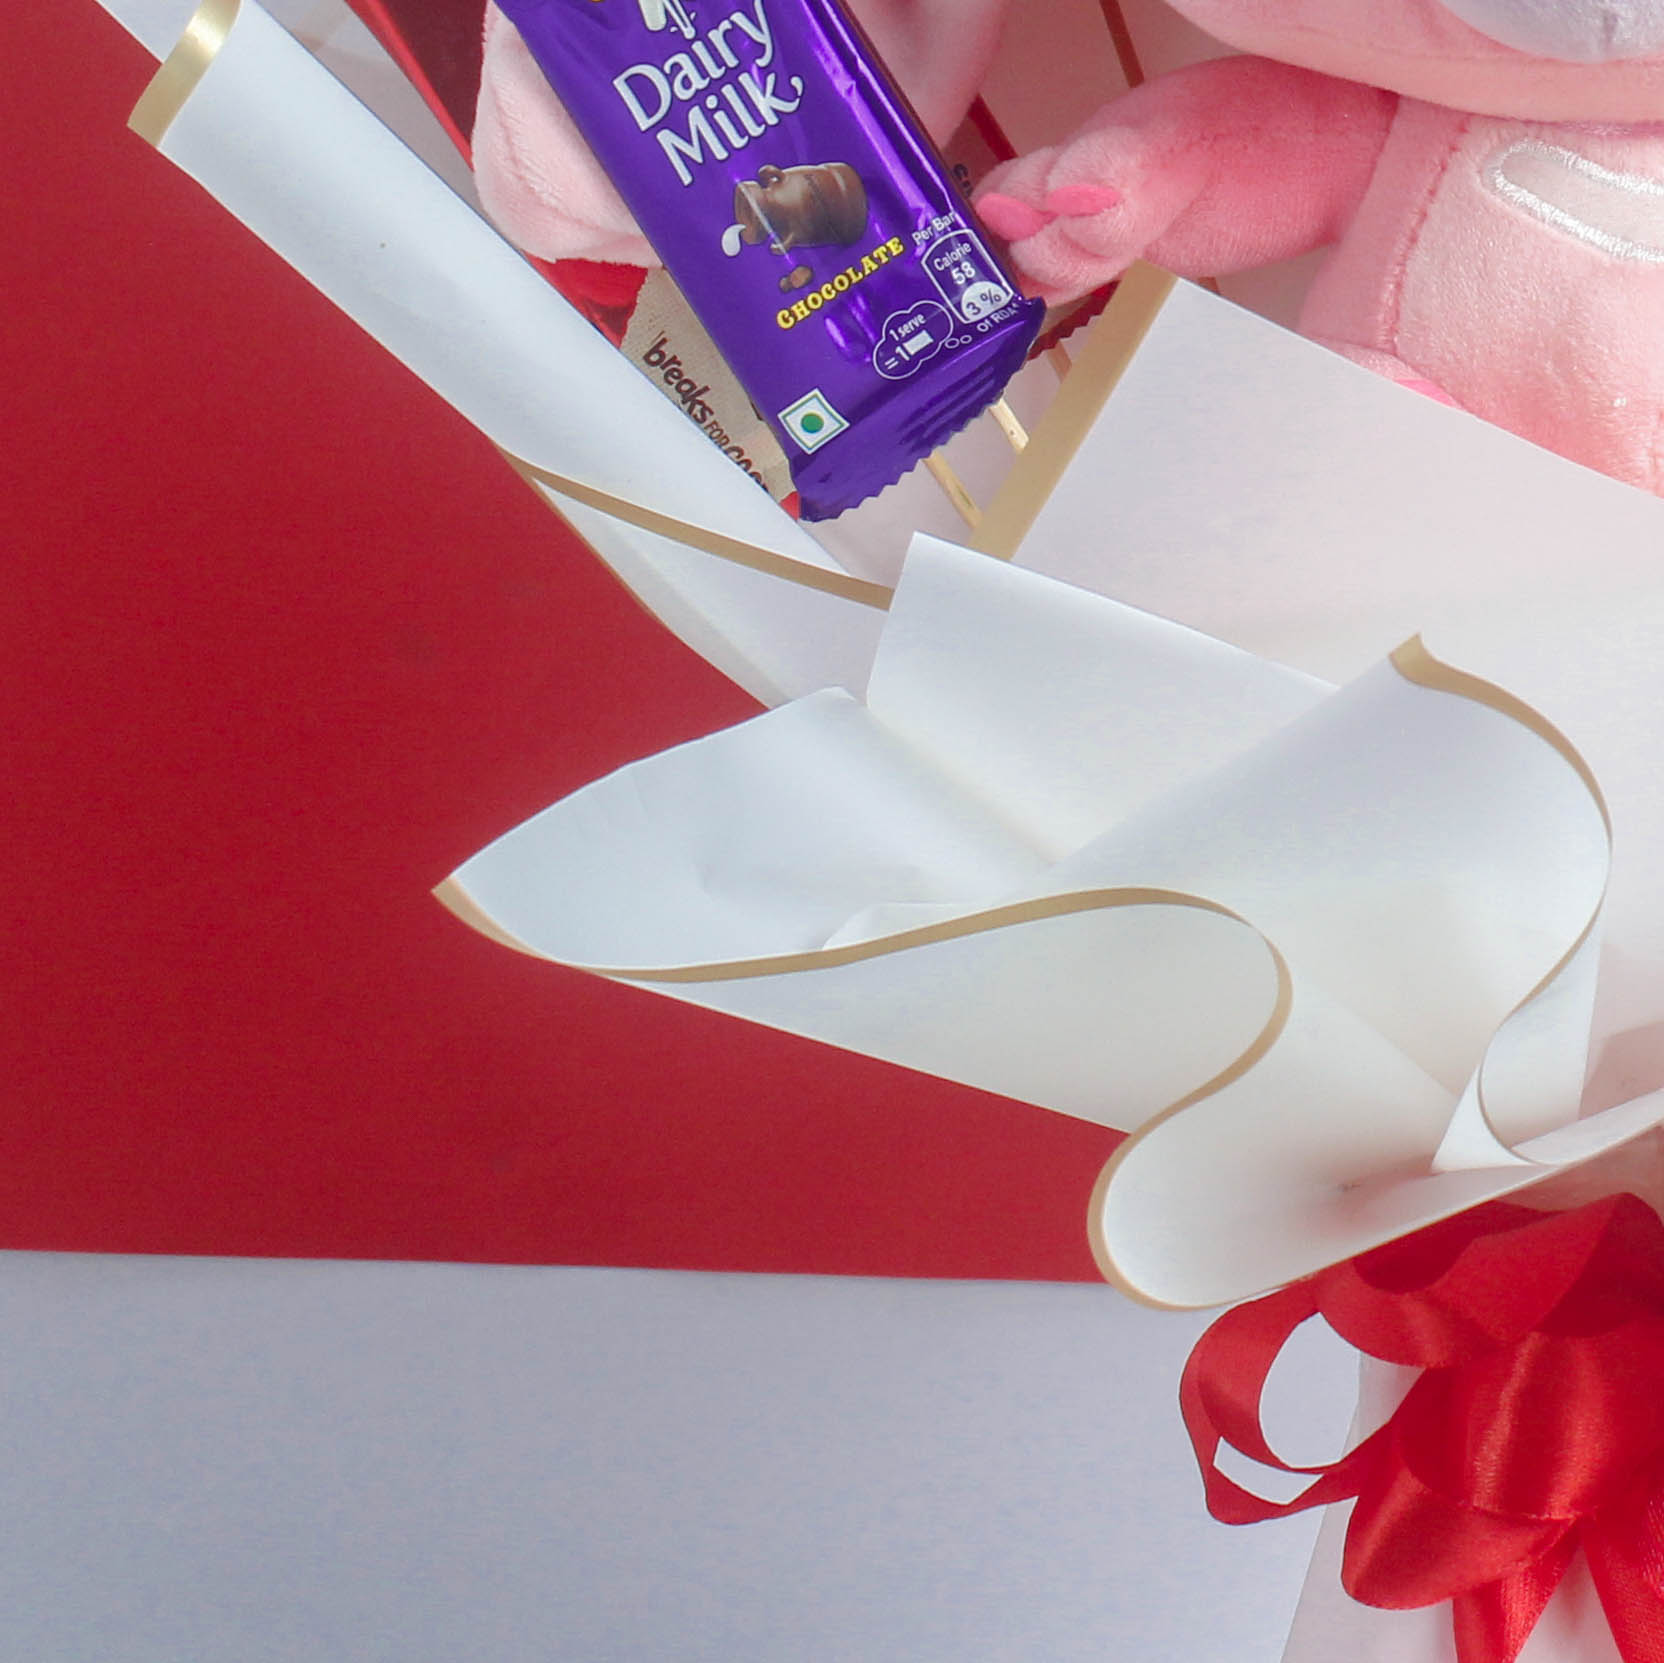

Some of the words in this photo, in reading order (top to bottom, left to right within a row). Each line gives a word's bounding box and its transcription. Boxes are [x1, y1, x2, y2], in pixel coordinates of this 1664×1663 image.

[656, 71, 803, 187] Milk
[911, 226, 934, 246] Per
[932, 211, 956, 232] Bar
[933, 241, 972, 272] Calorie
[951, 261, 976, 285] 58
[776, 236, 904, 330] CHOCOLATE
[898, 312, 927, 340] serve
[642, 336, 715, 425] breaks
